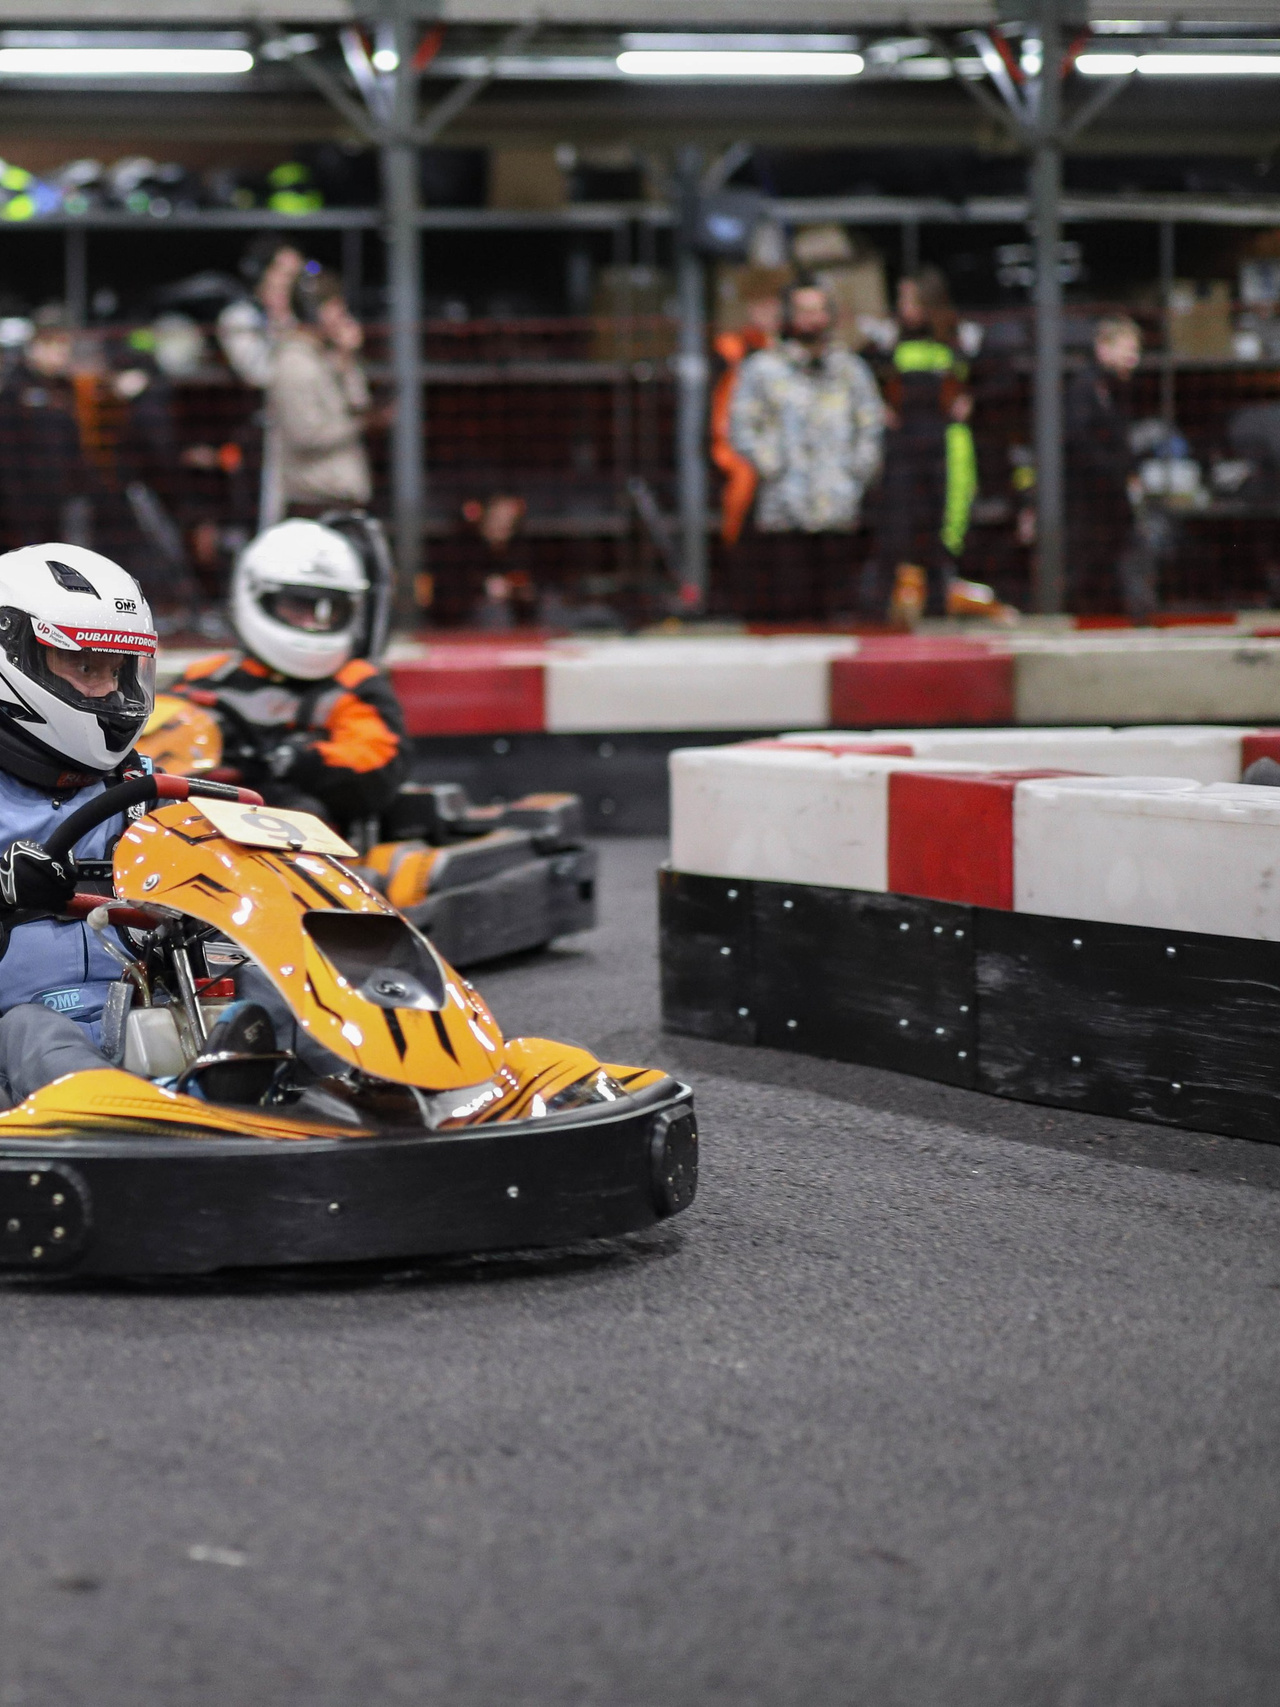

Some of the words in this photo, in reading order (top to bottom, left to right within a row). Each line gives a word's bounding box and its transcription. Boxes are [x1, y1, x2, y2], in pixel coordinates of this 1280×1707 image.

[115, 600, 136, 611] OMP
[51, 630, 64, 640] Union
[75, 631, 112, 642] DUBAI
[49, 635, 71, 648] Properties
[91, 646, 152, 657] WWW.DUBAIAUTOD.
[240, 813, 308, 843] 9
[44, 992, 81, 1010] OMP
